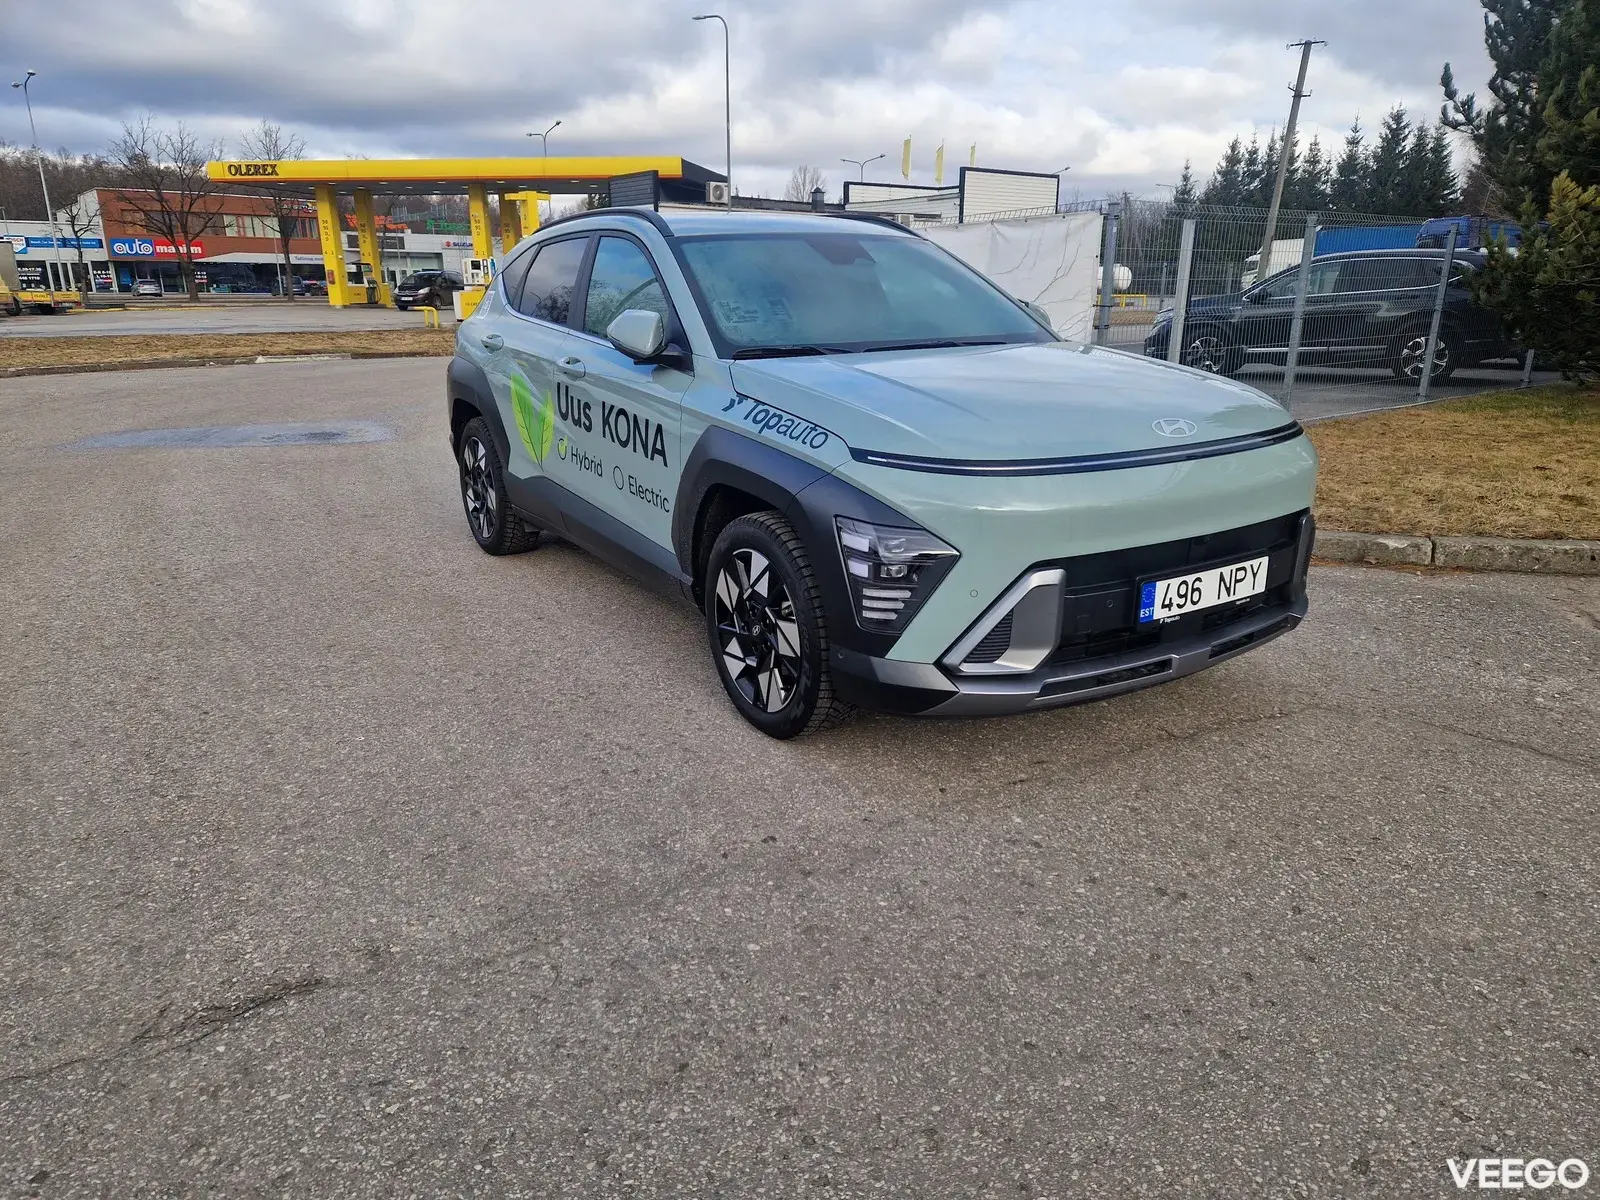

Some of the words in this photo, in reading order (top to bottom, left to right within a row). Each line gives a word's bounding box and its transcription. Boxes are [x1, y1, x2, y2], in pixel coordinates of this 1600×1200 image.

[227, 163, 279, 177] OLEREX
[113, 238, 153, 254] auto
[156, 244, 202, 254] maim
[557, 382, 593, 433] Uus
[602, 400, 668, 468] KONA
[743, 400, 829, 449] Topauto
[571, 445, 603, 478] Hybrid
[628, 474, 670, 513] Electric
[1161, 576, 1203, 612] 496
[1217, 561, 1262, 600] NPY
[1140, 607, 1154, 617] EST
